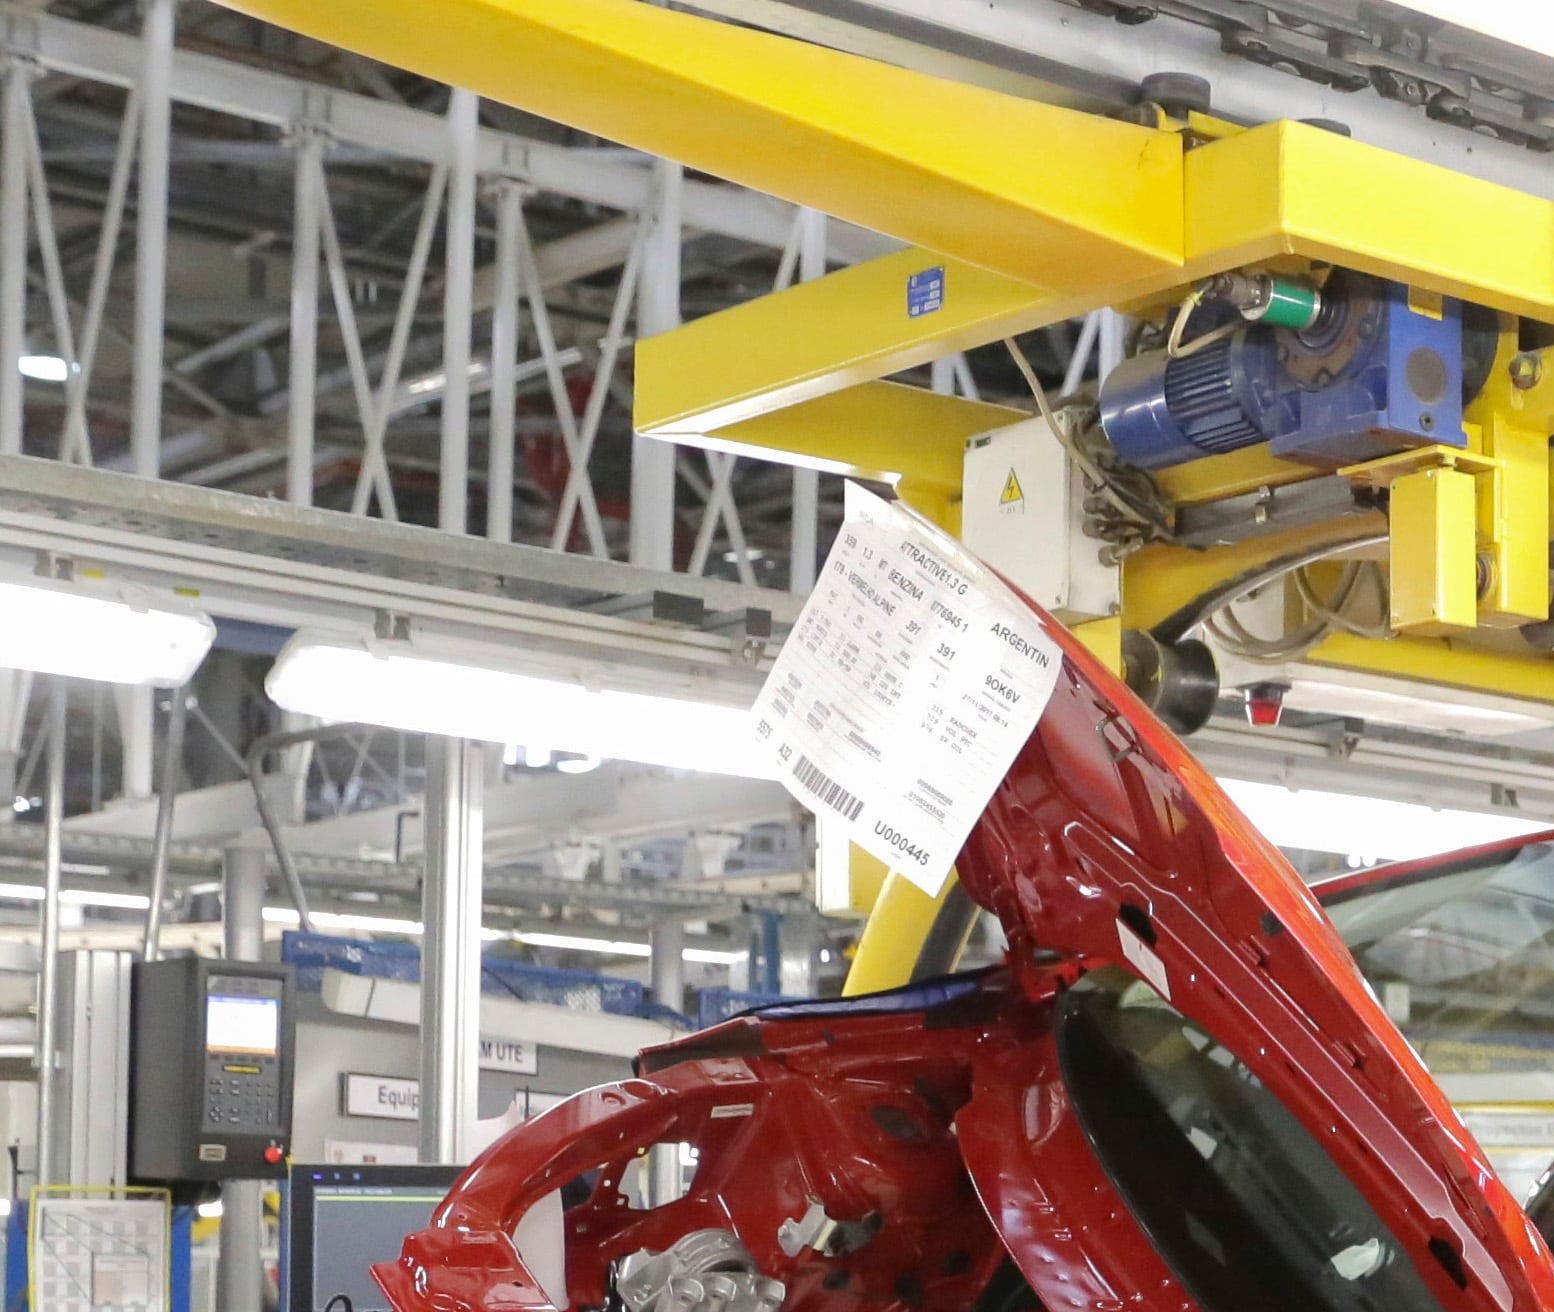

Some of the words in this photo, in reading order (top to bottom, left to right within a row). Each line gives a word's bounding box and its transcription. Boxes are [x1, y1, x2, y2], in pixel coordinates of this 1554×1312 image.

[886, 568, 926, 601] BENZINA
[937, 643, 956, 660] 391
[872, 820, 931, 867] U000445
[497, 1043, 524, 1063] UTE
